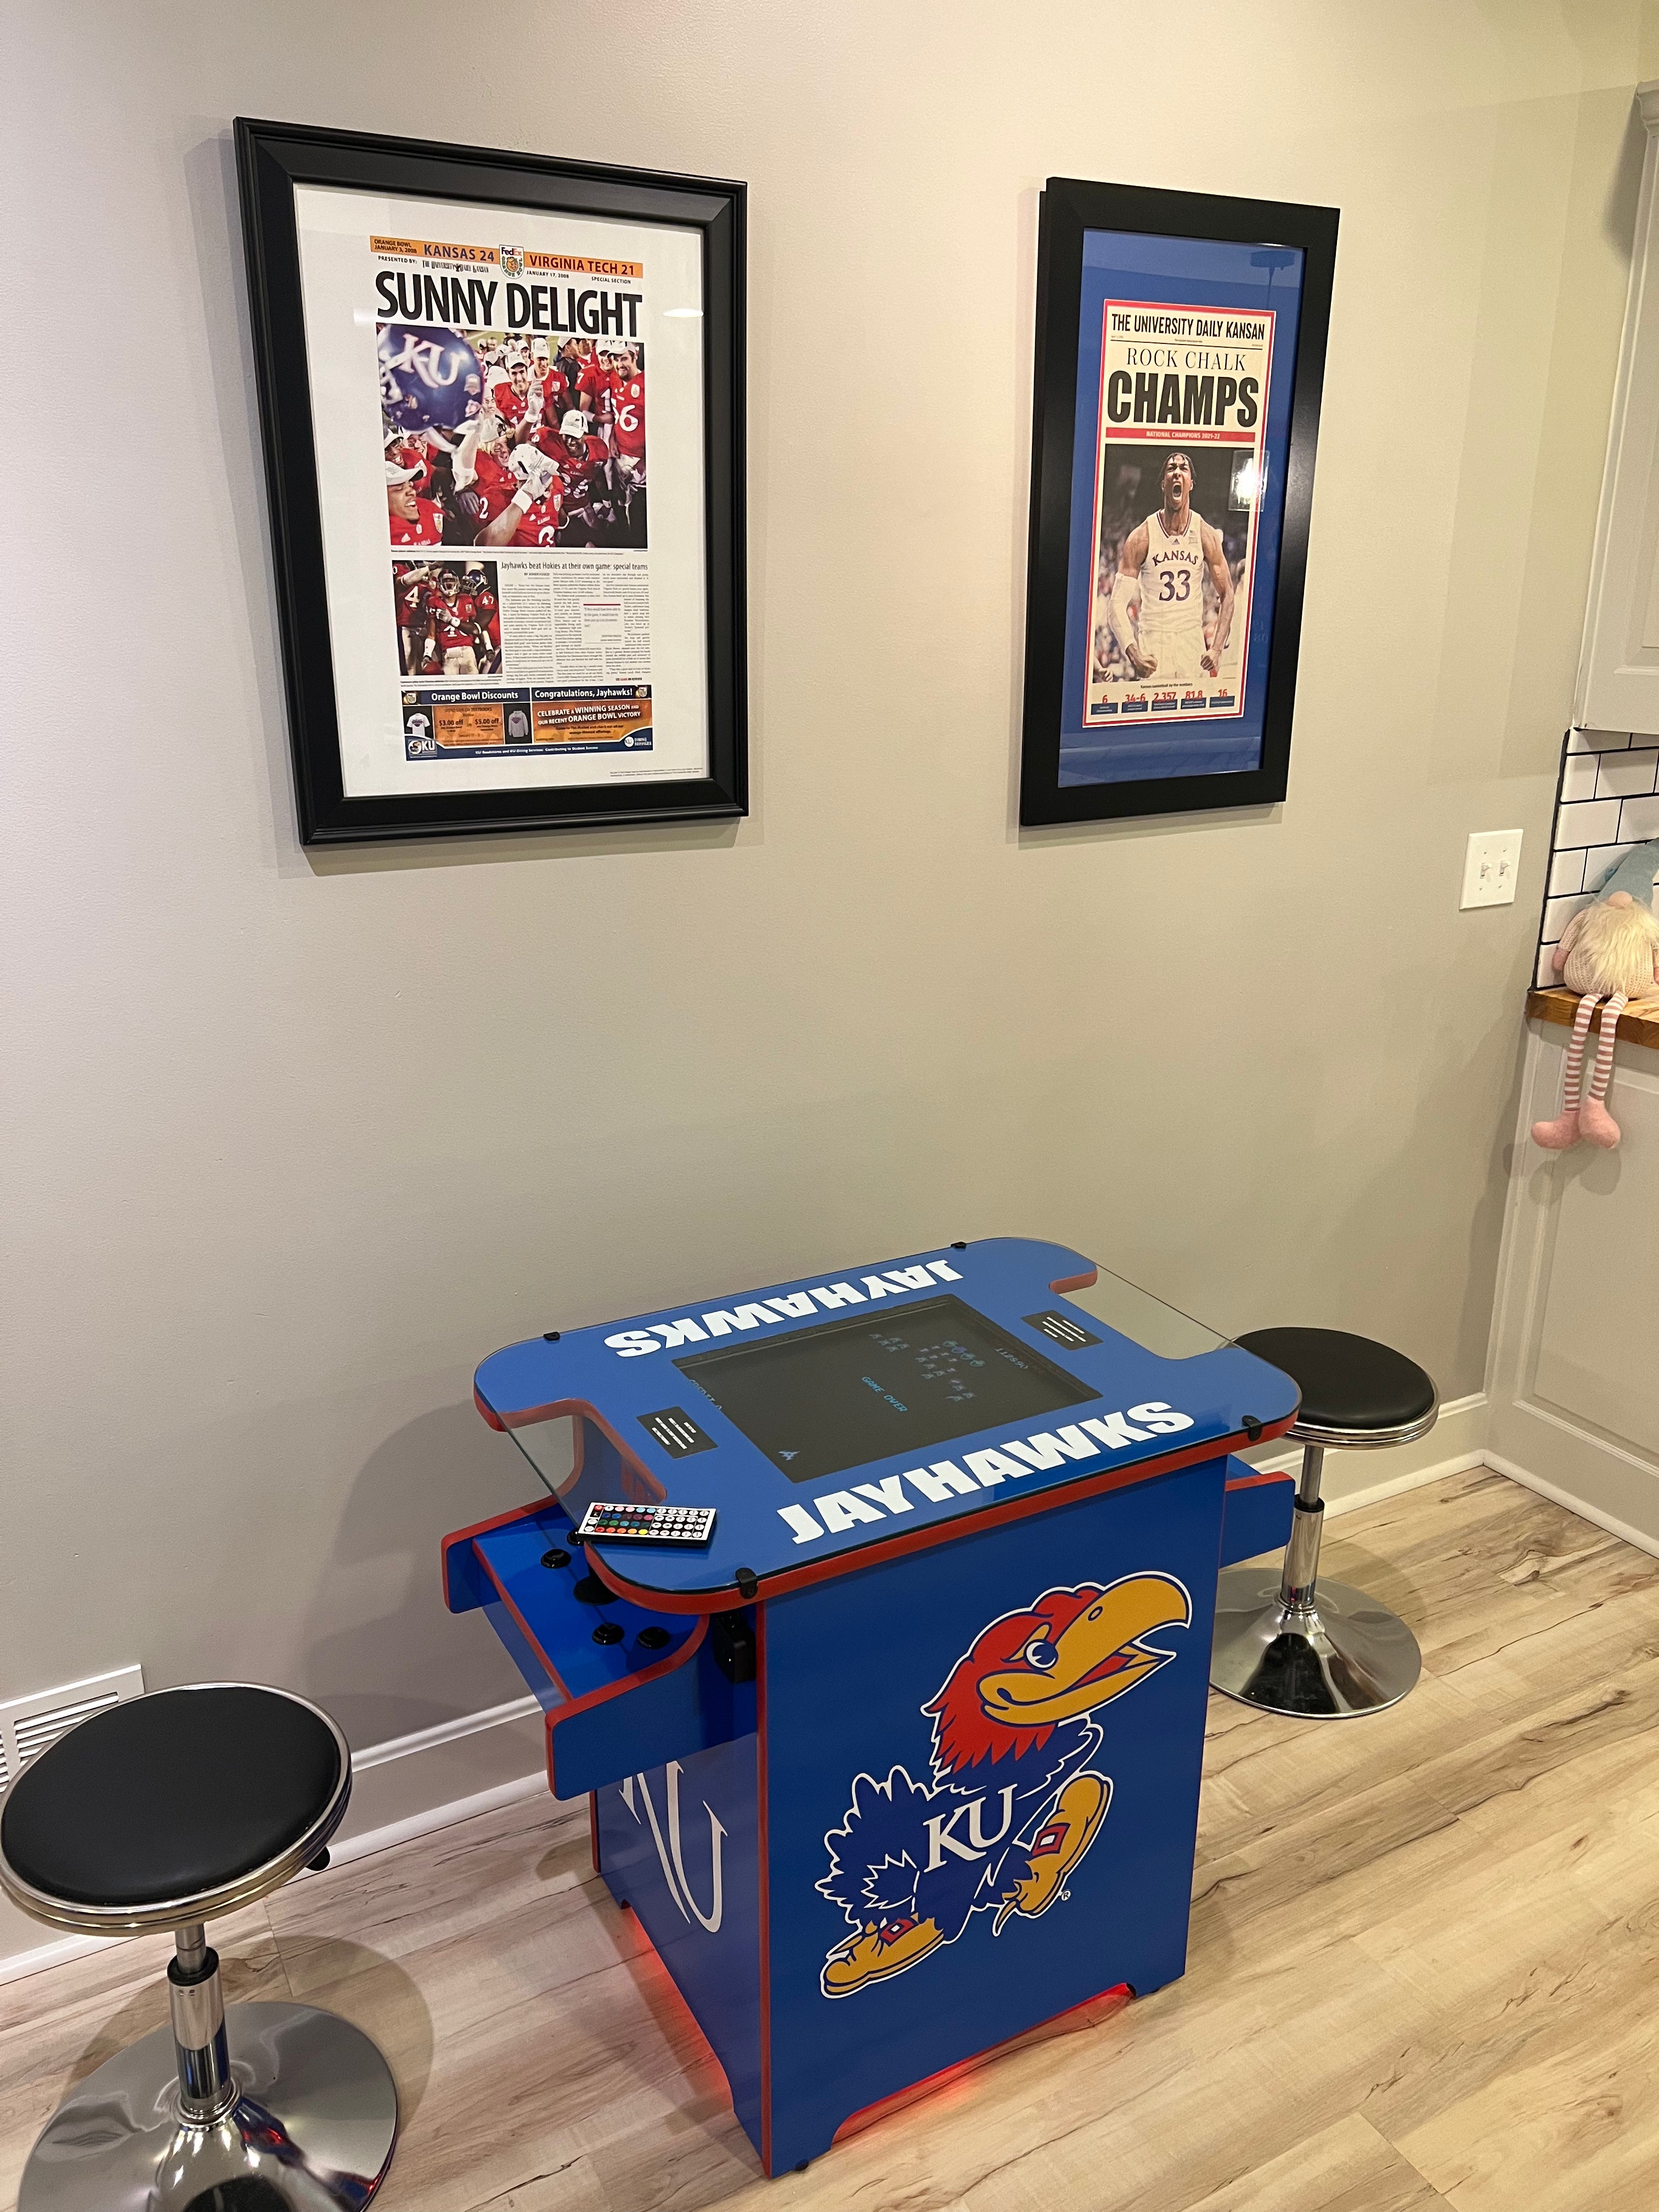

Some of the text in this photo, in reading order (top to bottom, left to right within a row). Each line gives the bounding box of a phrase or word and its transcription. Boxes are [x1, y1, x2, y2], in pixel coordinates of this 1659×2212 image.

[424, 244, 495, 262] KANSAS 24
[501, 247, 522, 256] FedEx
[529, 255, 634, 275] VIRGINIA TECH 21
[376, 271, 642, 337] SUNNY DELIGHT
[1111, 313, 1265, 341] THE UNIVERSITY DAILY KANSAN
[403, 333, 469, 389] KU
[1126, 348, 1246, 371] ROCK CHALK
[1107, 370, 1259, 427] CHAMPS
[501, 562, 527, 571] Jayhawks
[613, 562, 631, 571] special
[1152, 550, 1200, 567] KANSAS
[1159, 569, 1191, 602] 33
[431, 691, 518, 702] Orange Bowl Discounts
[535, 688, 633, 699] Congratulations, Jayhawks!
[1102, 695, 1108, 704] 6
[1125, 693, 1146, 703] 34-6
[1153, 691, 1177, 702] 2,357
[1218, 689, 1228, 697] 16
[537, 709, 570, 717] CELEBRATE
[574, 705, 607, 714] WINNING
[568, 714, 596, 723] ORANGE
[597, 712, 617, 720] BOWL
[422, 740, 435, 751] KU
[603, 1259, 963, 1358] JAYHAWKS
[862, 1377, 908, 1412] GAME OVER
[776, 1401, 1195, 1544] JAYHAWKS
[923, 1784, 1017, 1873] KU
